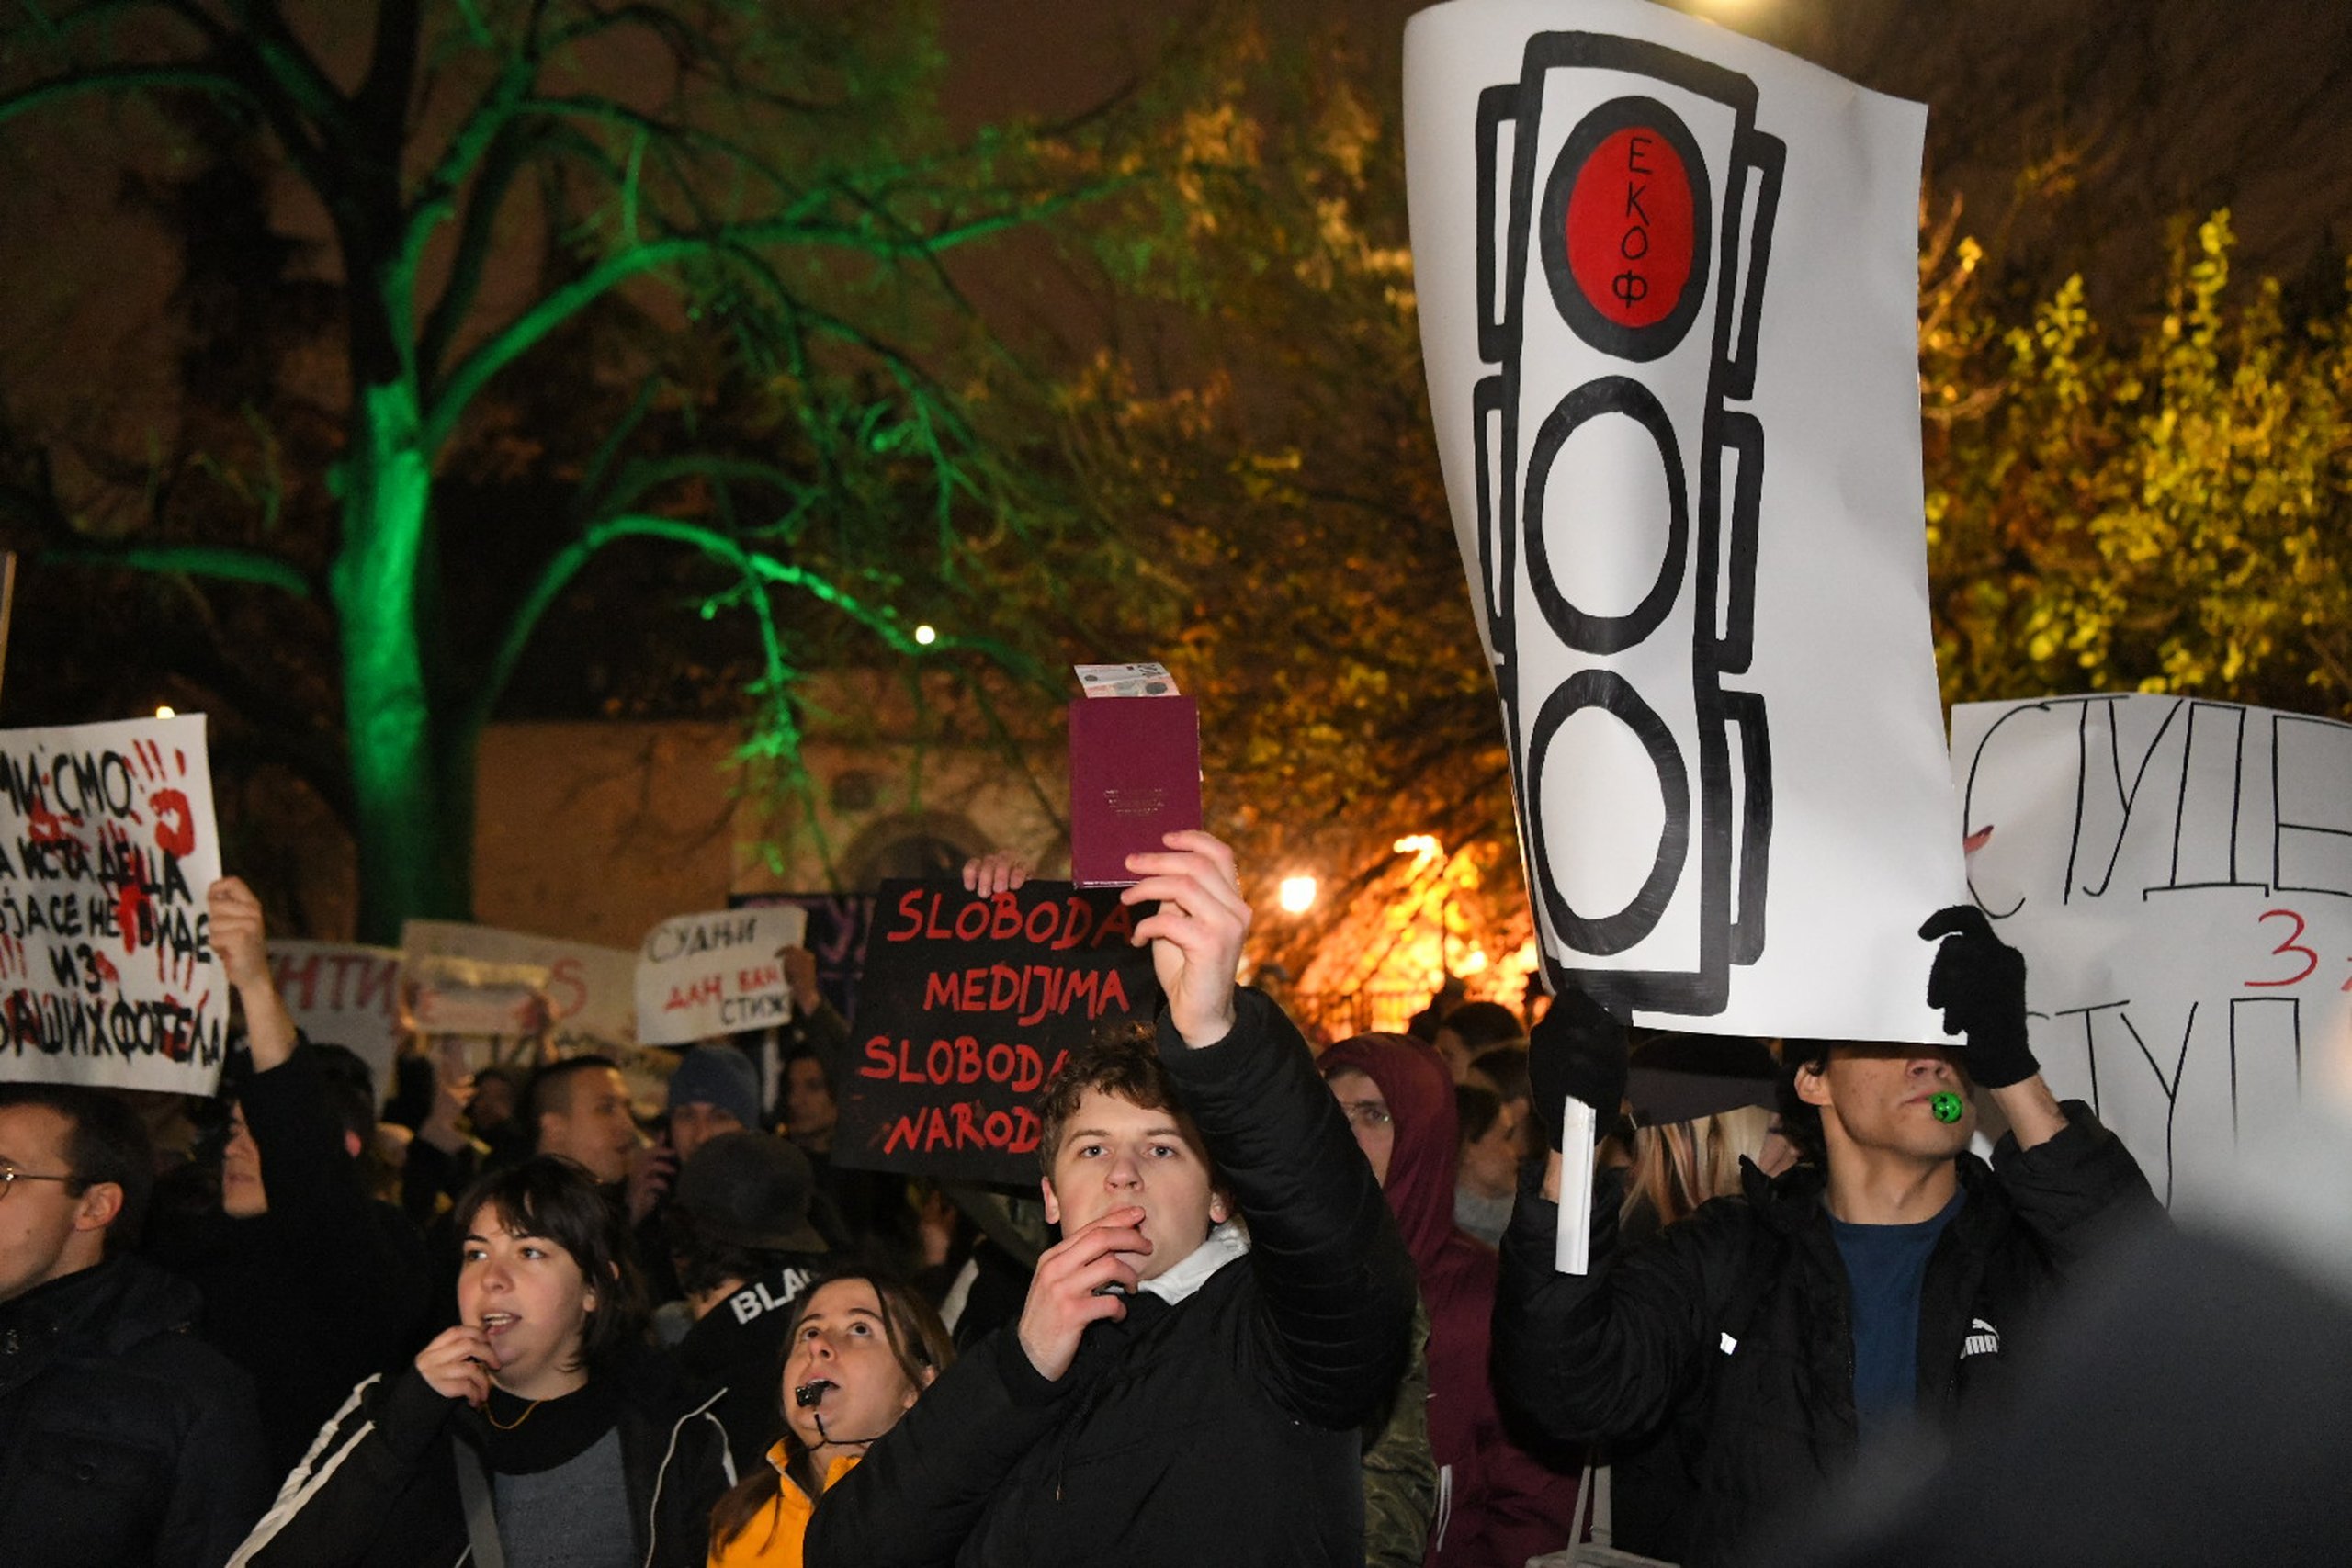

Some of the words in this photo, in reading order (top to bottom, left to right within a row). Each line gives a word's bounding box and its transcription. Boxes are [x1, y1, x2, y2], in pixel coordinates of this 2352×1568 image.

[1612, 136, 1653, 310] ЕКОФ
[52, 749, 132, 818] СМО
[887, 889, 1133, 951] SLOBODA
[48, 942, 102, 994] ИЗ
[266, 953, 401, 1015] НТИ
[663, 974, 722, 1013] ДАН
[922, 962, 1130, 1027] MEDIJIMA
[2026, 998, 2301, 1210] ТУП
